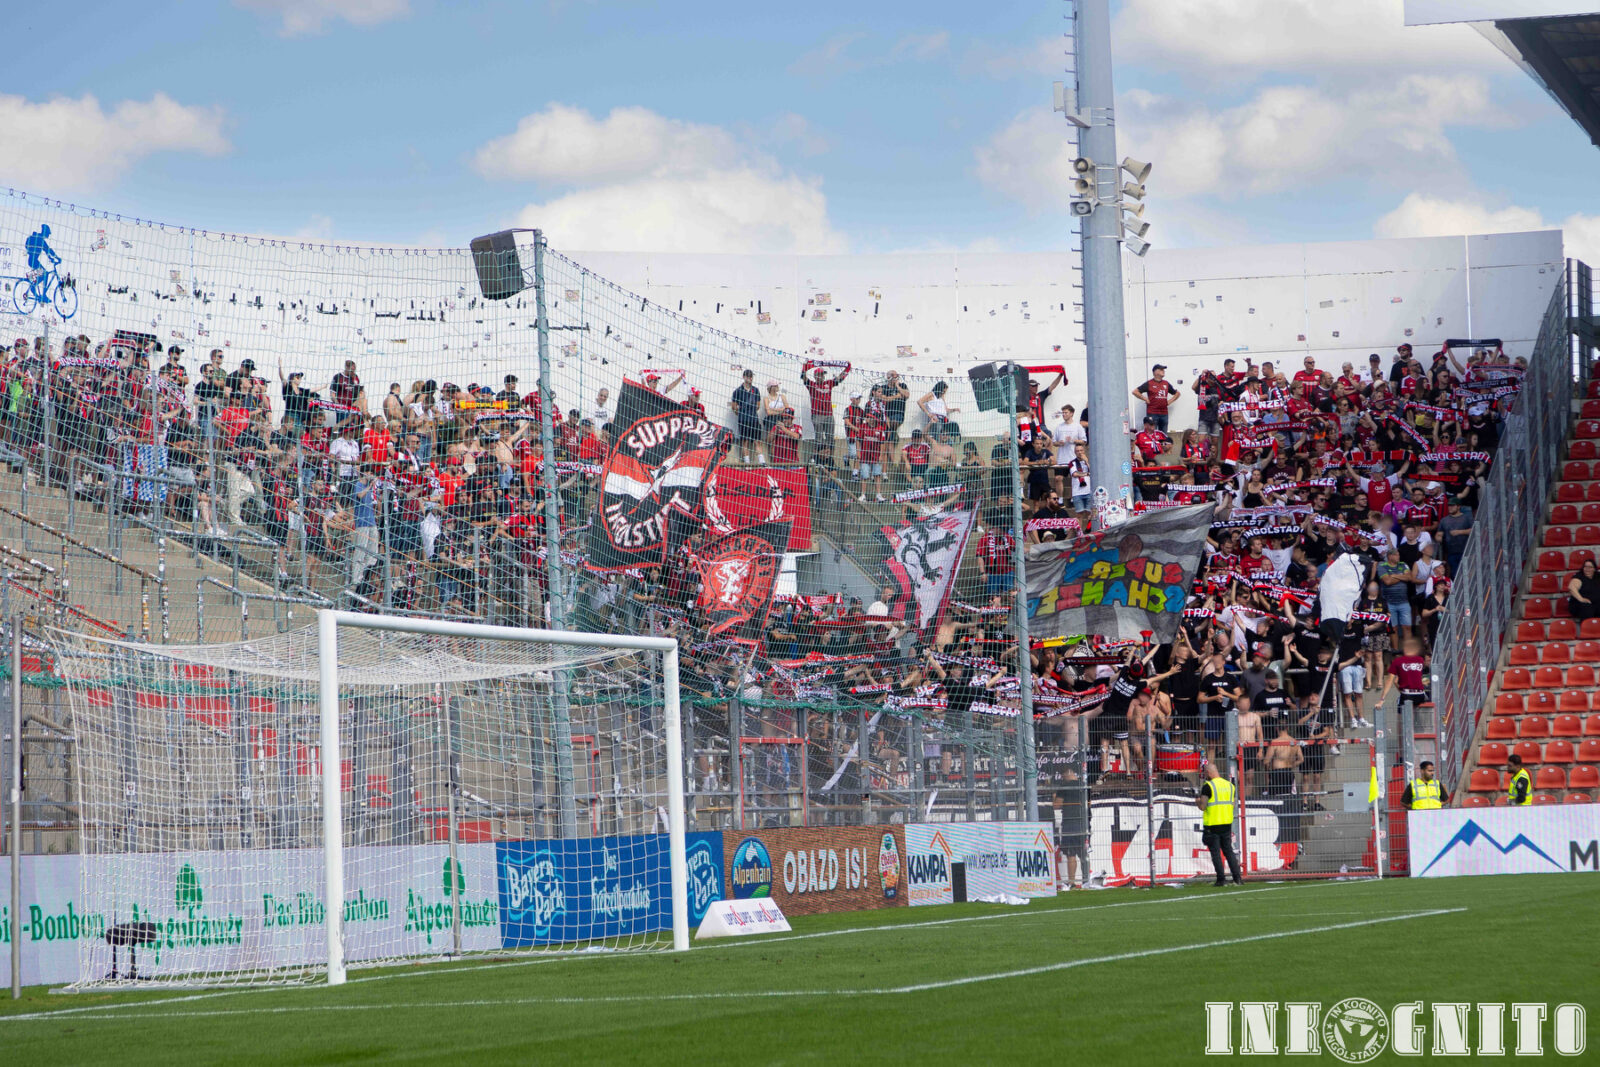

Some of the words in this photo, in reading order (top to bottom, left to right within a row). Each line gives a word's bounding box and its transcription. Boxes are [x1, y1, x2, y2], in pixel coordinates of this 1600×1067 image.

[1210, 519, 1265, 529] OLSTADT
[733, 863, 771, 888] Alpenhain
[784, 848, 839, 894] OBAZD
[845, 847, 868, 890] IS!
[907, 854, 948, 884] KAMPA
[1015, 850, 1050, 877] KAMPA
[507, 860, 554, 908] Bayern
[534, 876, 564, 926] Park
[693, 867, 719, 910] Park
[0, 900, 105, 943] i-Bonbon
[263, 893, 294, 927] Das
[297, 889, 389, 925] Bio-onbon
